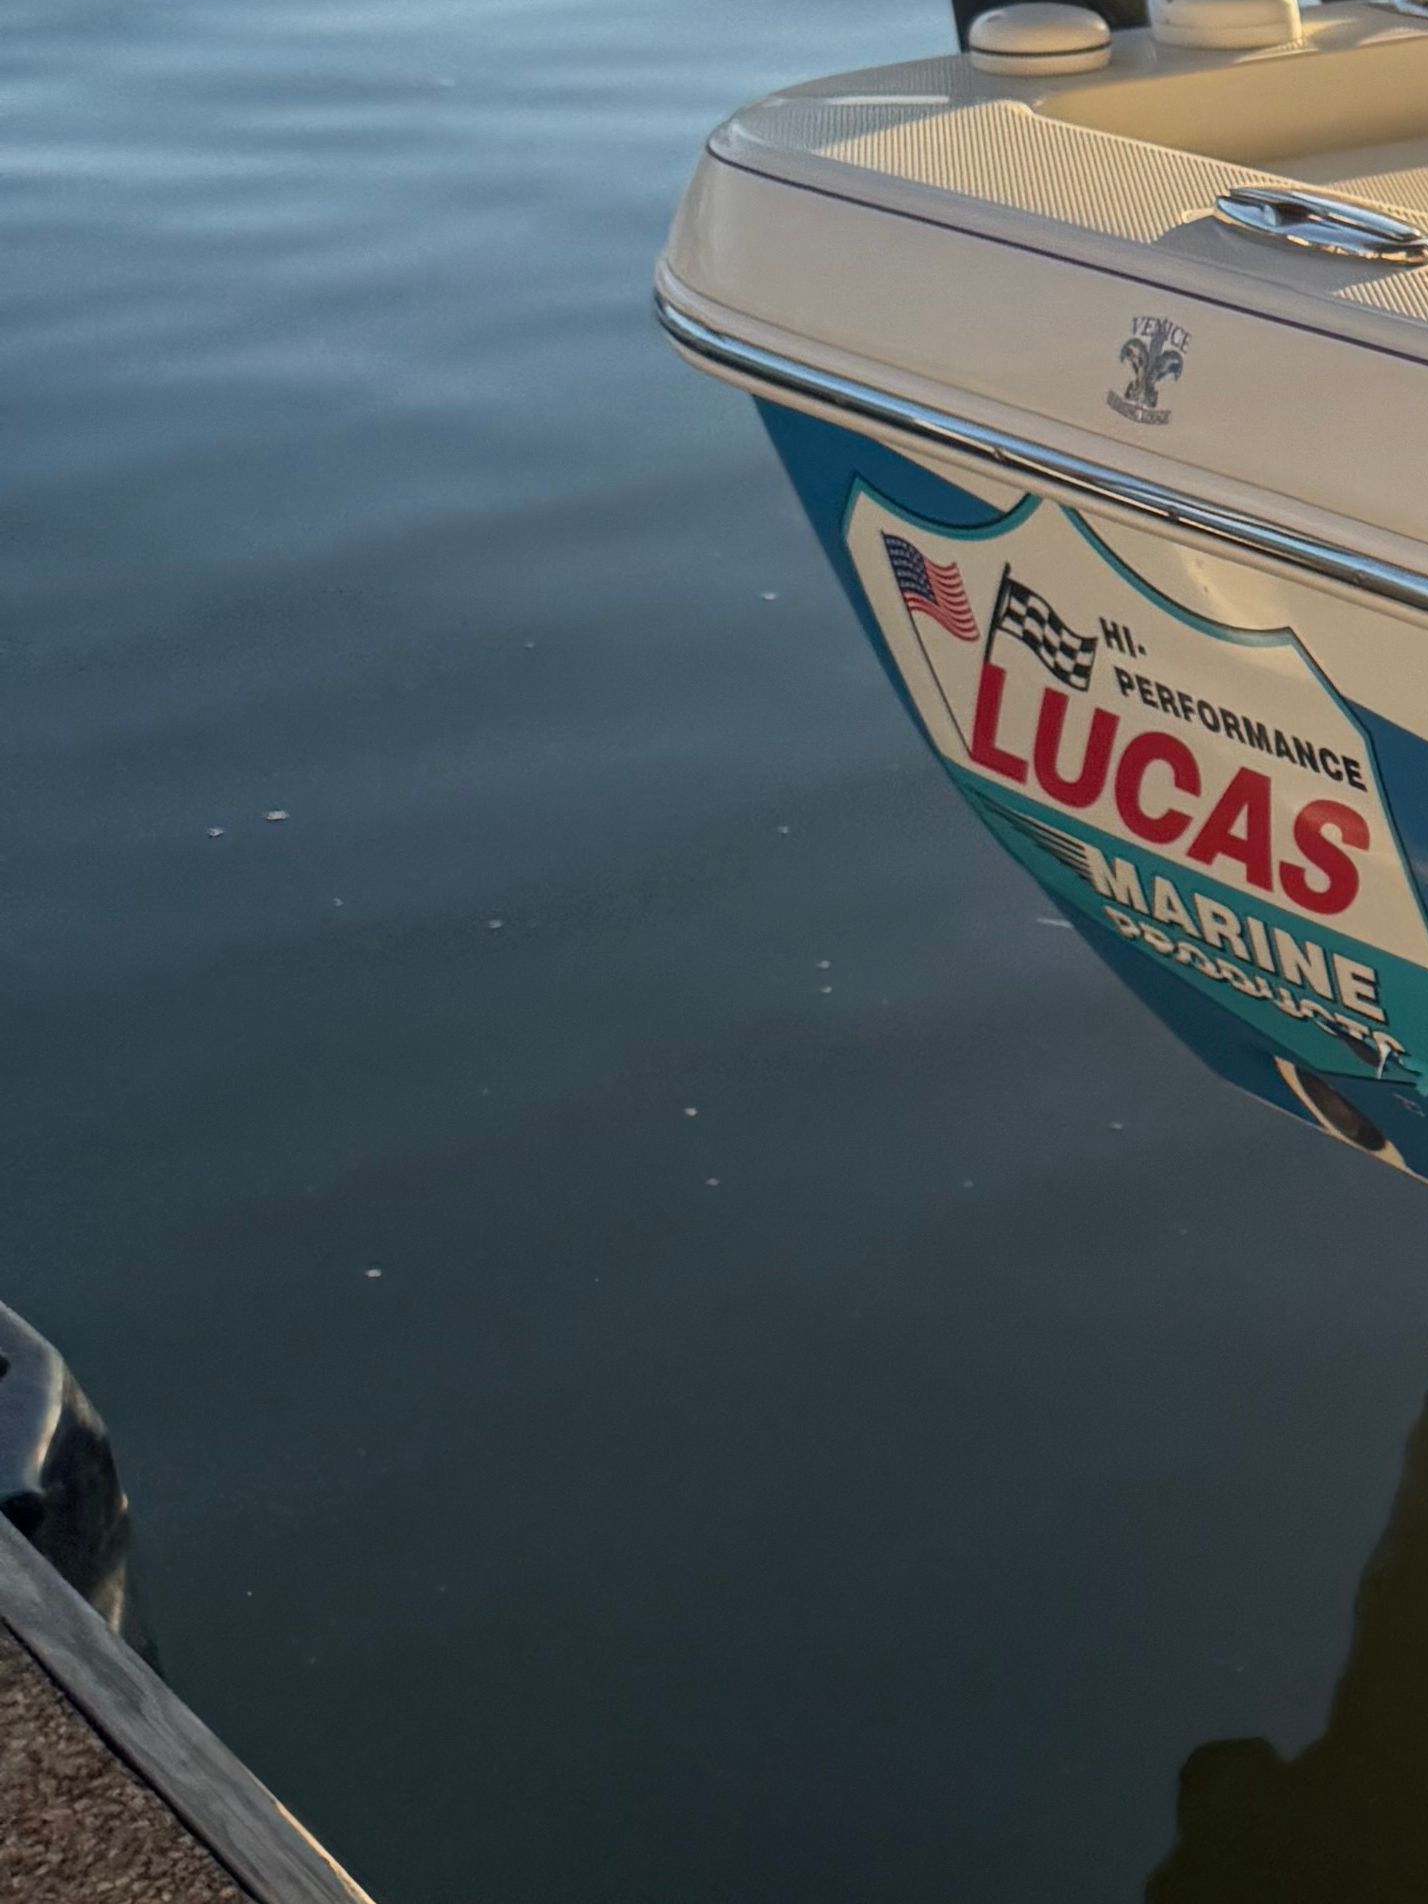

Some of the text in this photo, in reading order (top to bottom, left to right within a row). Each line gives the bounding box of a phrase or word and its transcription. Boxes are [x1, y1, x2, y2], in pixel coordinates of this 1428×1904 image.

[971, 661, 1371, 915] LUCAS
[1114, 666, 1368, 792] PERFORMANCE
[1084, 846, 1386, 1025] MARINE
